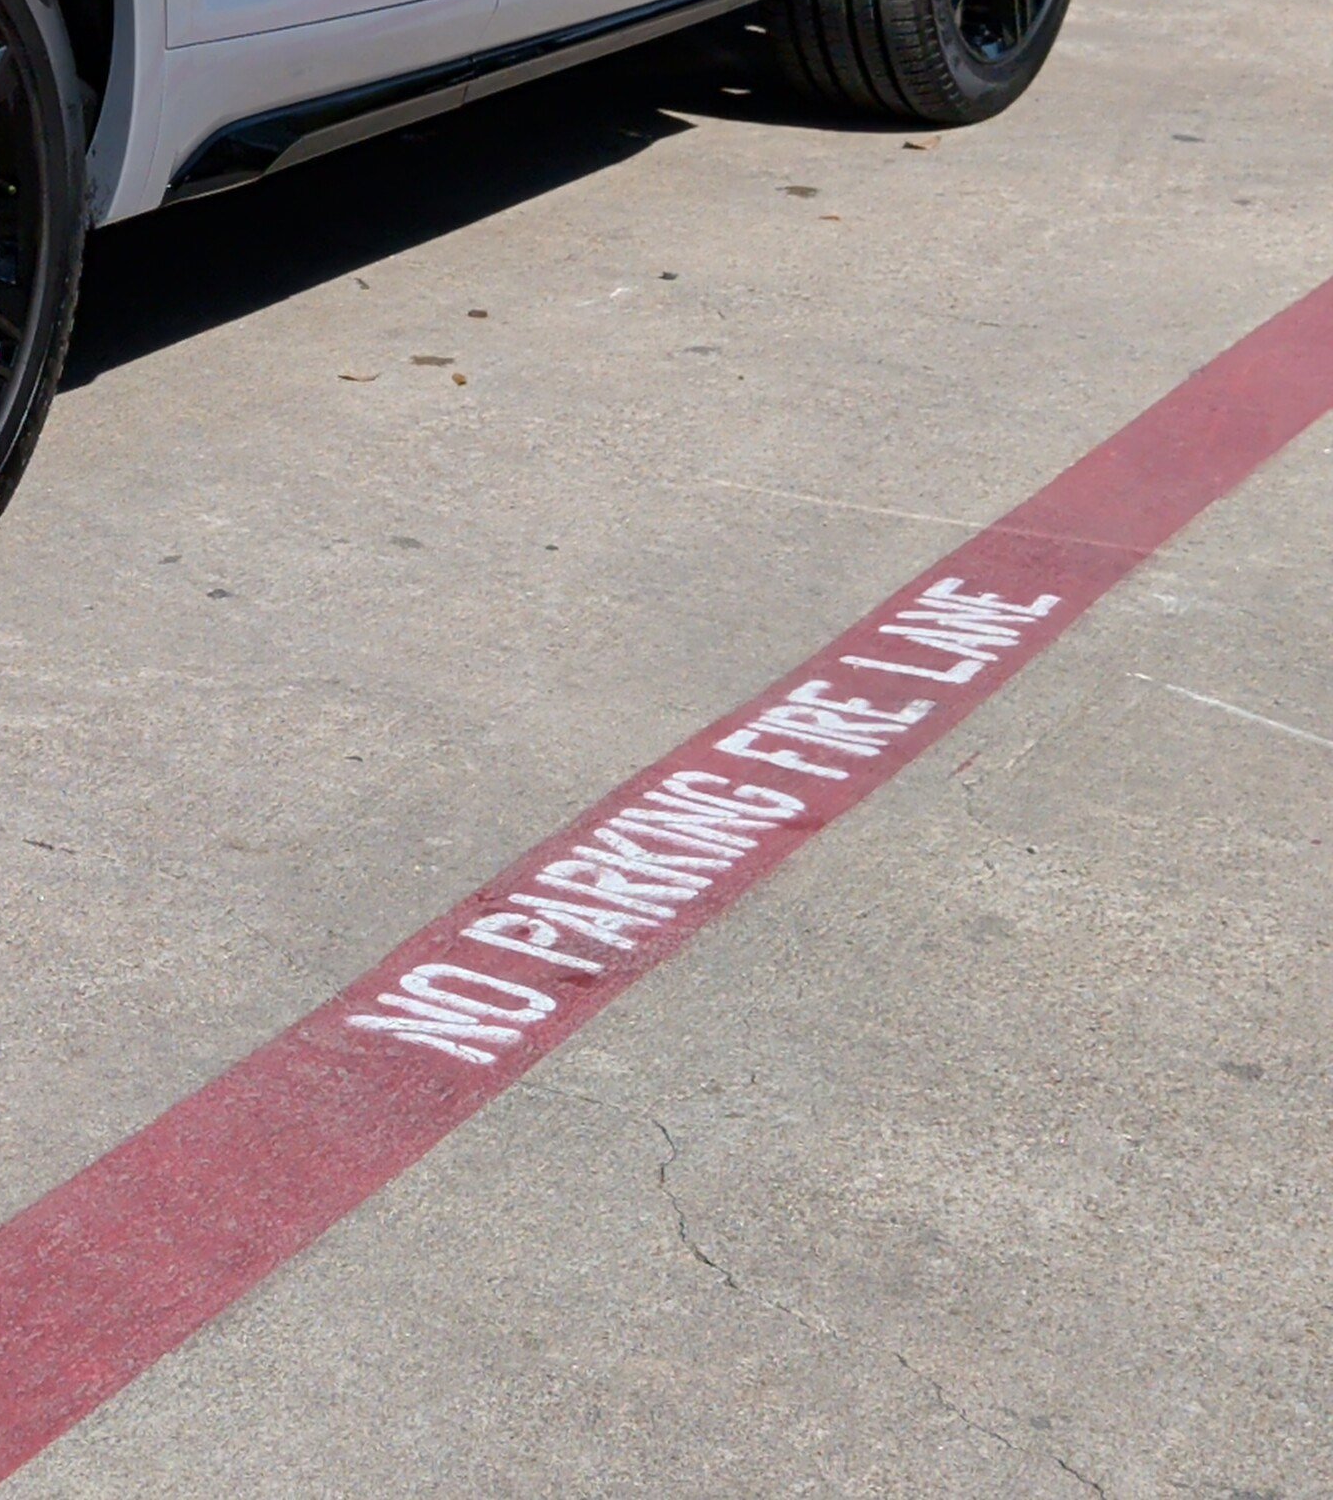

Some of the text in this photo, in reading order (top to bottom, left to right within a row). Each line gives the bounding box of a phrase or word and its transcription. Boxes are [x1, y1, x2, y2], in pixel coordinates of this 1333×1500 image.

[345, 577, 1062, 1064] NO PARKING FIRE LANE
